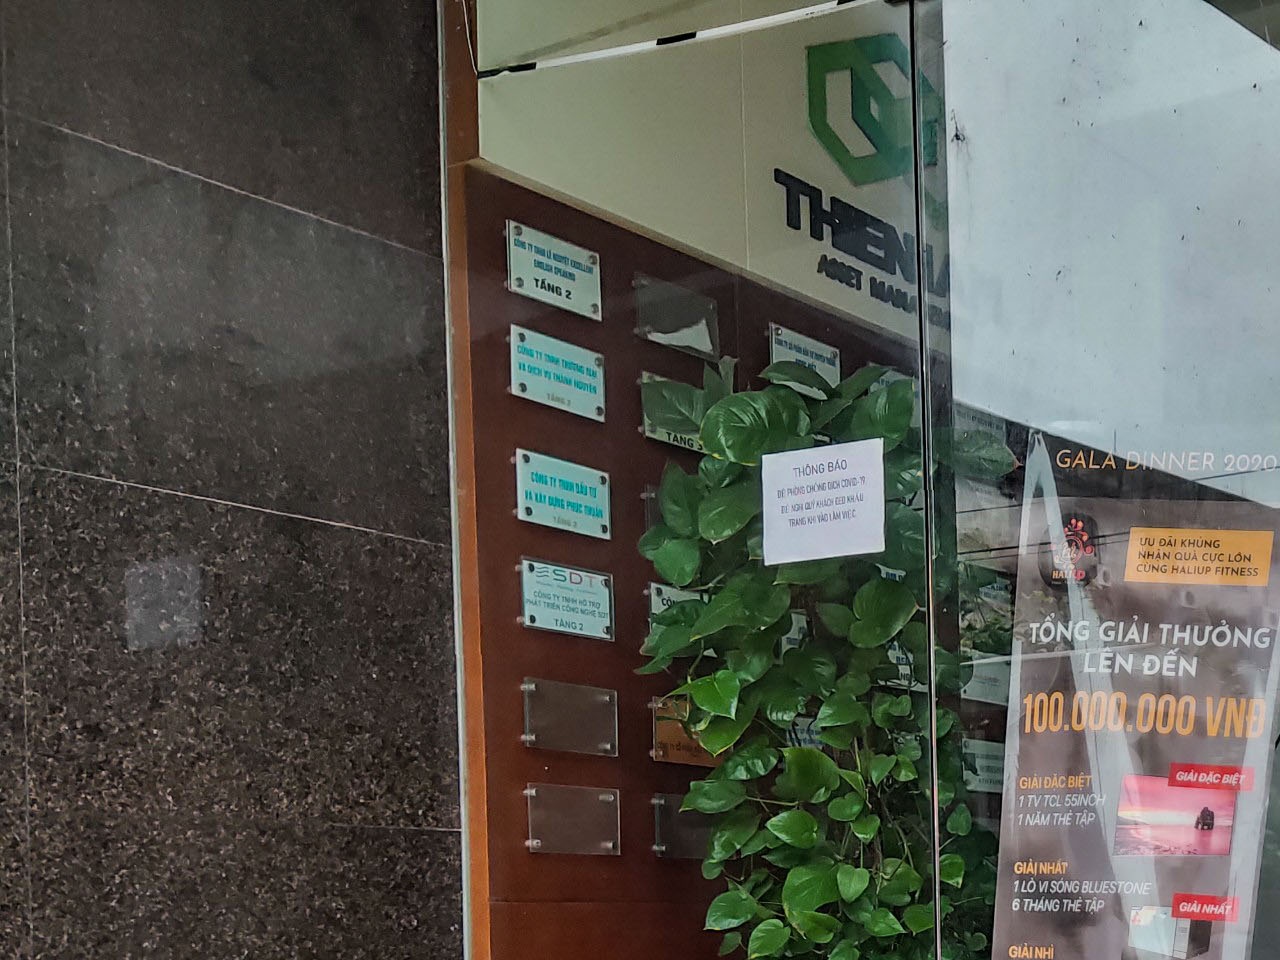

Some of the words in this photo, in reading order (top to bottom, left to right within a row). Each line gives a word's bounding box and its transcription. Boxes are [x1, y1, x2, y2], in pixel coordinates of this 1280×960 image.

[565, 289, 572, 300] 2
[793, 463, 825, 478] THÔNG
[827, 459, 848, 473] BÁO
[1056, 449, 1117, 470] GALA
[1125, 451, 1215, 472] DINNER
[1223, 454, 1278, 473] 2020
[1180, 536, 1221, 548] KHỦNG
[1136, 561, 1168, 574] CÙNG
[1171, 565, 1212, 575] HALIUP
[1214, 566, 1259, 577] FITNESS
[579, 623, 585, 631] 2
[1029, 613, 1090, 644] TỔNG
[1098, 615, 1150, 644] GIẢI
[1158, 619, 1272, 649] THƯỞNG
[1083, 647, 1133, 675] LÊN
[1142, 648, 1198, 678] ĐẾN
[1023, 690, 1197, 736] 100.000.000
[1206, 696, 1267, 738] VNĐ
[1019, 774, 1042, 789] GIẢI
[1044, 773, 1066, 791] ĐẶC
[1068, 771, 1093, 790] BIỆT
[1018, 795, 1024, 807] 1
[1027, 795, 1043, 807] TV
[1043, 794, 1062, 807] TCL
[1064, 793, 1106, 807] 55INCH
[1013, 880, 1019, 892] 1
[1021, 878, 1037, 893] LÒ
[1038, 881, 1049, 892] VI
[1050, 878, 1080, 893] SÓNG
[1081, 880, 1152, 895] BLUESTONE
[1179, 900, 1202, 913] GIẢI
[1202, 900, 1233, 915] NHẤT
